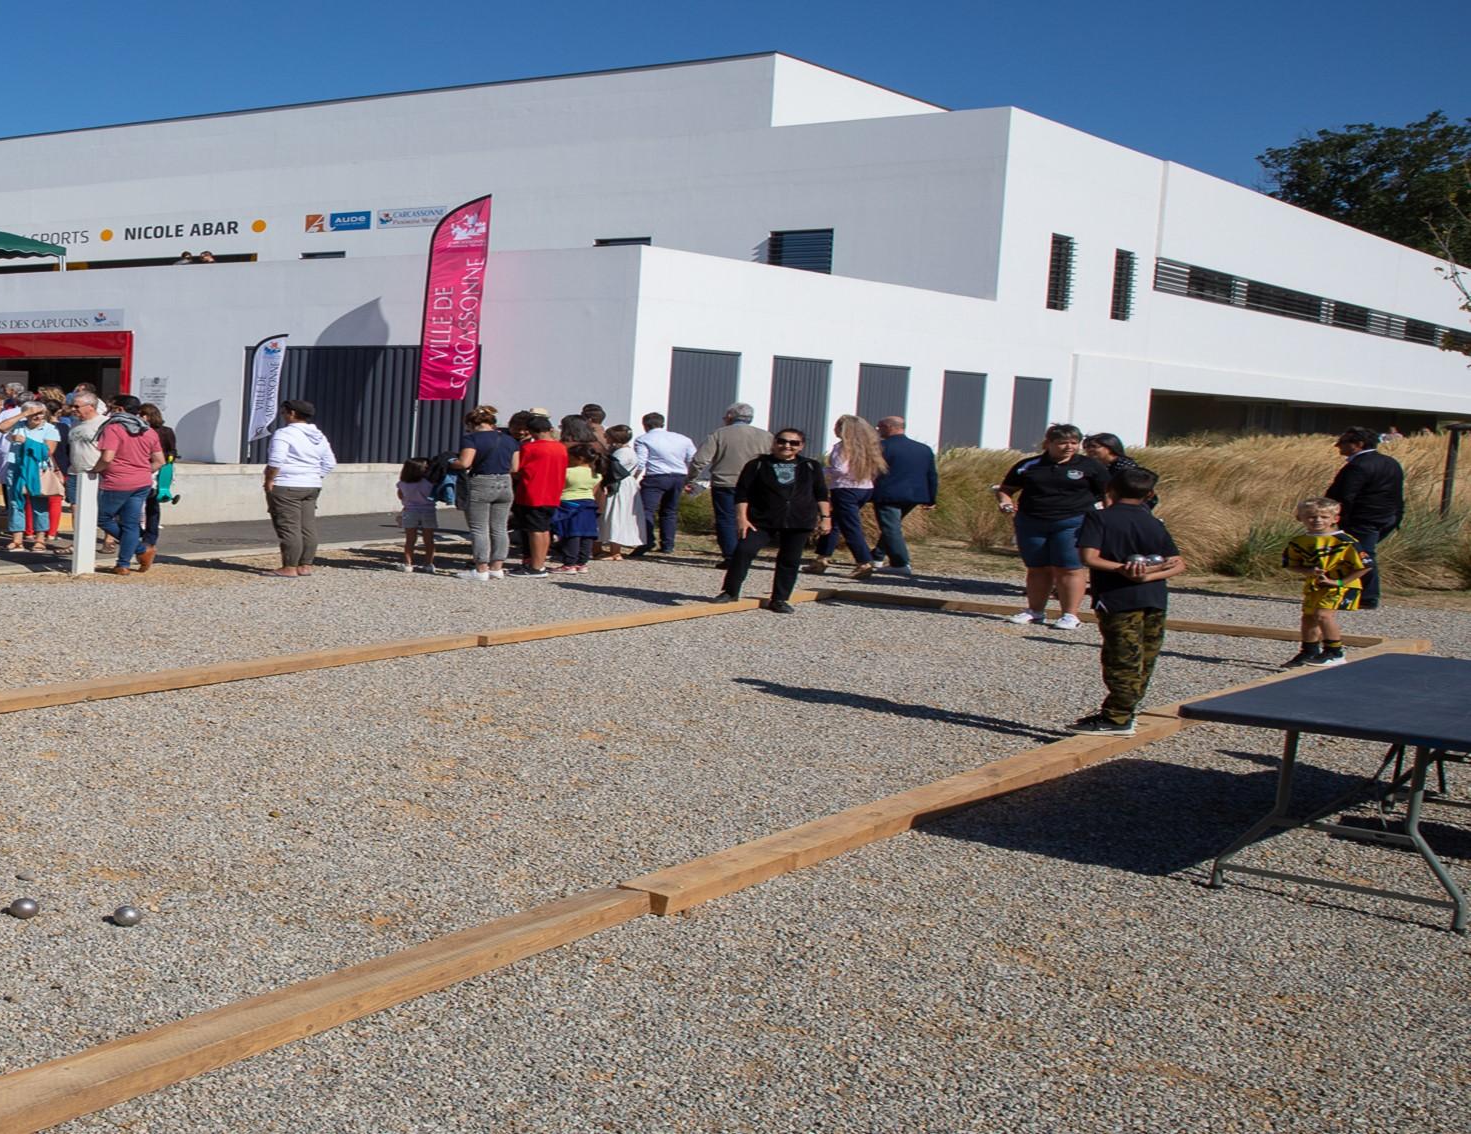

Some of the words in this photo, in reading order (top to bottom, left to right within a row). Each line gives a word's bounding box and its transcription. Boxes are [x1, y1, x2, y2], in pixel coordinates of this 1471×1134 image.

[124, 223, 184, 241] NICOLE
[190, 221, 239, 236] ABAR
[433, 286, 454, 311] DE
[10, 319, 29, 329] DES
[32, 317, 89, 329] CAPUCINS
[450, 257, 485, 397] CARCASSONNE
[430, 315, 453, 361] VILLE
